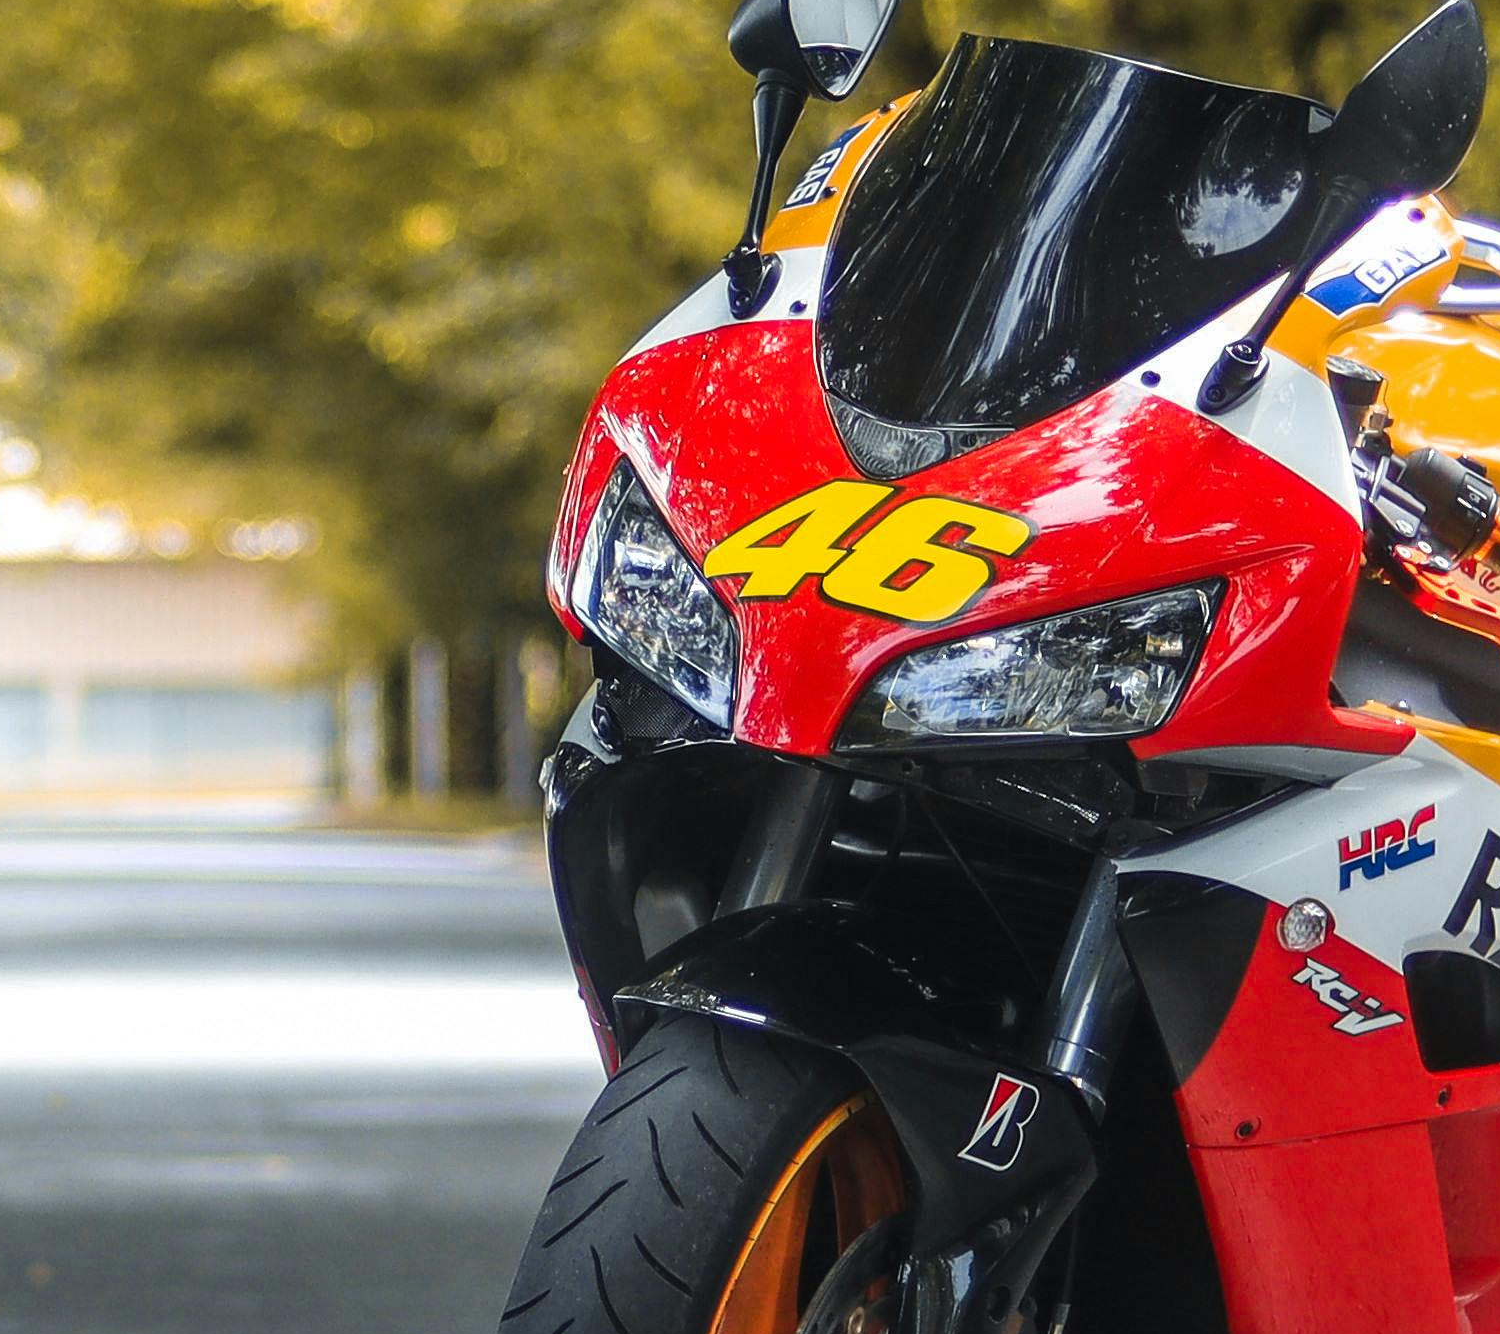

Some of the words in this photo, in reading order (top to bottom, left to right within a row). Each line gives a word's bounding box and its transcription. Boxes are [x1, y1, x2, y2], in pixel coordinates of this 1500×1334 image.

[786, 147, 841, 205] GAS
[703, 478, 1037, 625] 46
[1338, 803, 1436, 892] HRC
